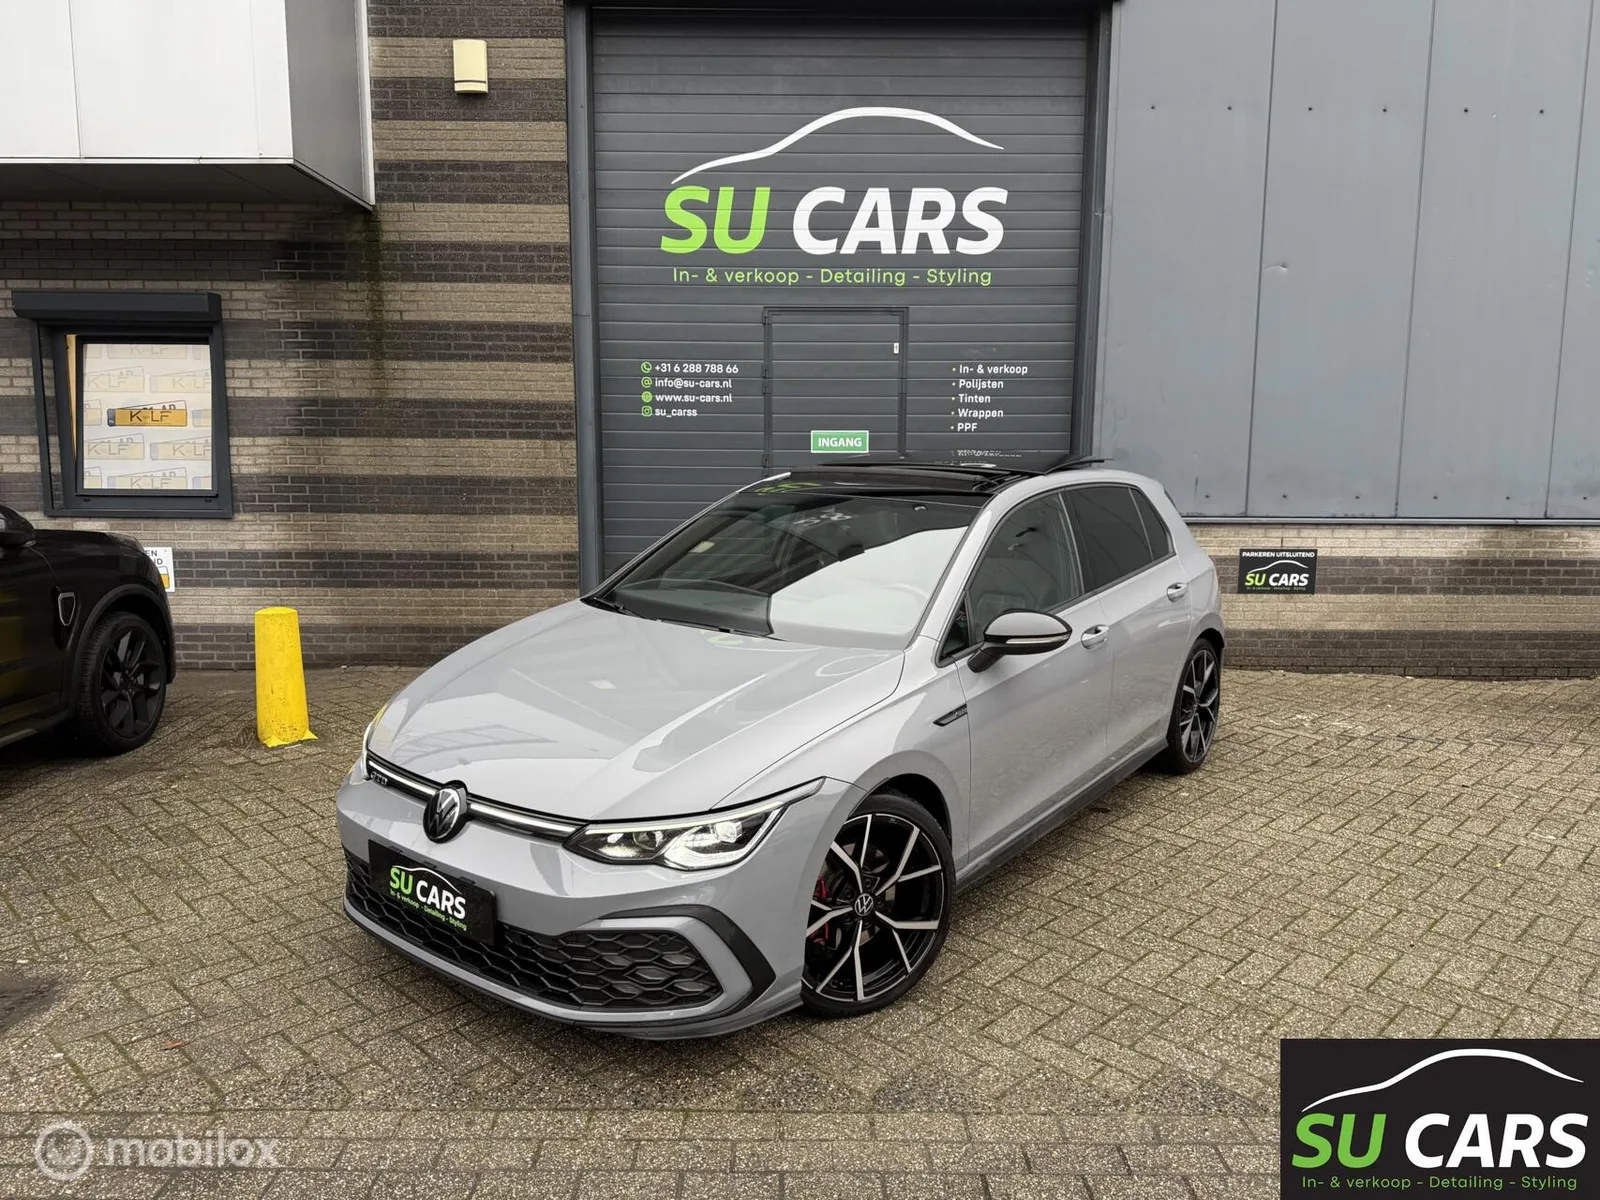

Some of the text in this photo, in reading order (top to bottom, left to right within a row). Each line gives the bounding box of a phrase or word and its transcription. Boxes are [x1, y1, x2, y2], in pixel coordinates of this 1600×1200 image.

[661, 185, 1008, 255] SU CARS
[673, 268, 699, 282] In-
[706, 268, 718, 282] &
[725, 268, 799, 286] verkoop
[820, 268, 905, 286] Detailing
[927, 268, 992, 286] Styling
[655, 363, 739, 373] +31 6 288 788 66
[959, 364, 1028, 375] In- & verkoop
[655, 378, 732, 389] info@su-cars.nl
[959, 379, 1004, 390] Polijsten
[655, 393, 732, 403] www.su-cars.nl
[958, 393, 991, 403] Tinten
[655, 408, 698, 417] su_carss
[957, 408, 1004, 419] Wrappen
[957, 423, 978, 431] PPF
[818, 437, 862, 447] INGANG
[1244, 573, 1309, 586] SU CARS
[389, 867, 466, 919] SU CARS
